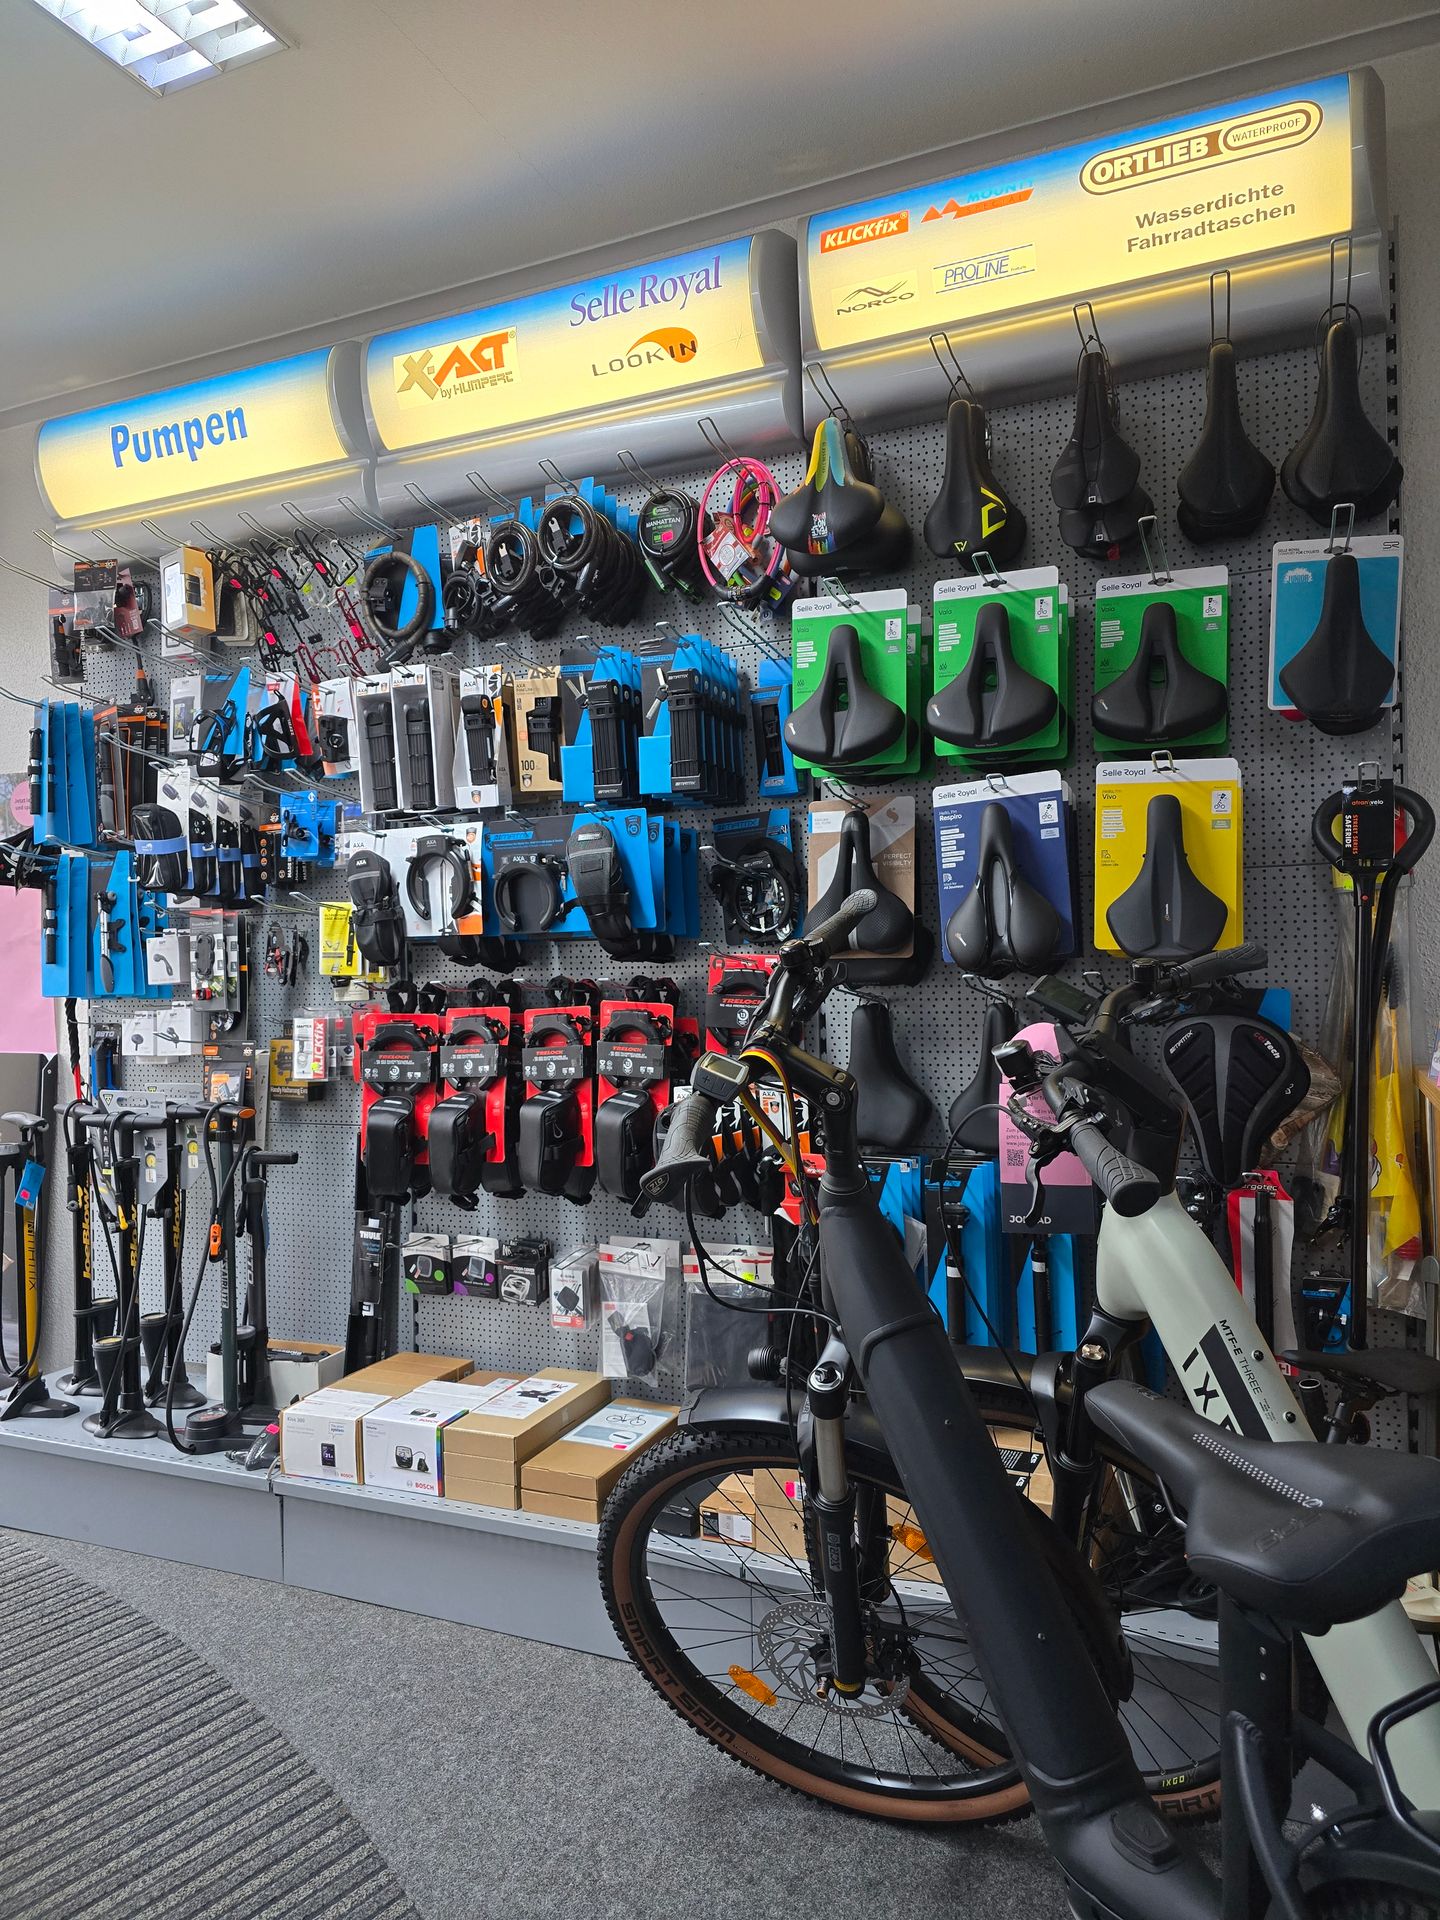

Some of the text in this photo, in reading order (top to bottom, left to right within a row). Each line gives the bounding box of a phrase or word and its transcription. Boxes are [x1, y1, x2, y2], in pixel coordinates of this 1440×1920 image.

[1094, 117, 1302, 184] ORTLIEB WATERPROOF
[1135, 183, 1285, 229] Wasserdichte
[825, 219, 899, 249] KLICKfix
[1127, 201, 1296, 252] Fahrradtaschen
[944, 258, 1009, 285] PROLINE
[570, 256, 723, 327] Selle Royal
[836, 292, 914, 316] NORCO
[440, 386, 452, 399] by
[111, 407, 248, 468] Pumpen
[646, 517, 681, 528] MANHATTAN
[957, 583, 977, 591] Royal
[1101, 581, 1142, 592] Selle Royal
[521, 760, 535, 771] 100
[1124, 768, 1146, 776] Royal
[938, 788, 977, 800] Selle Royal
[939, 814, 962, 822] Respiro
[1009, 1215, 1052, 1225] JOAD
[83, 1186, 91, 1279] JoeBlow
[221, 1270, 229, 1308] AIRLITE
[1219, 1320, 1263, 1395] MTF-E THREE
[415, 1483, 435, 1491] BOSCH
[621, 1602, 737, 1744] SMART SAM
[1162, 1775, 1185, 1787] IXGO
[1158, 1789, 1217, 1814] ART
